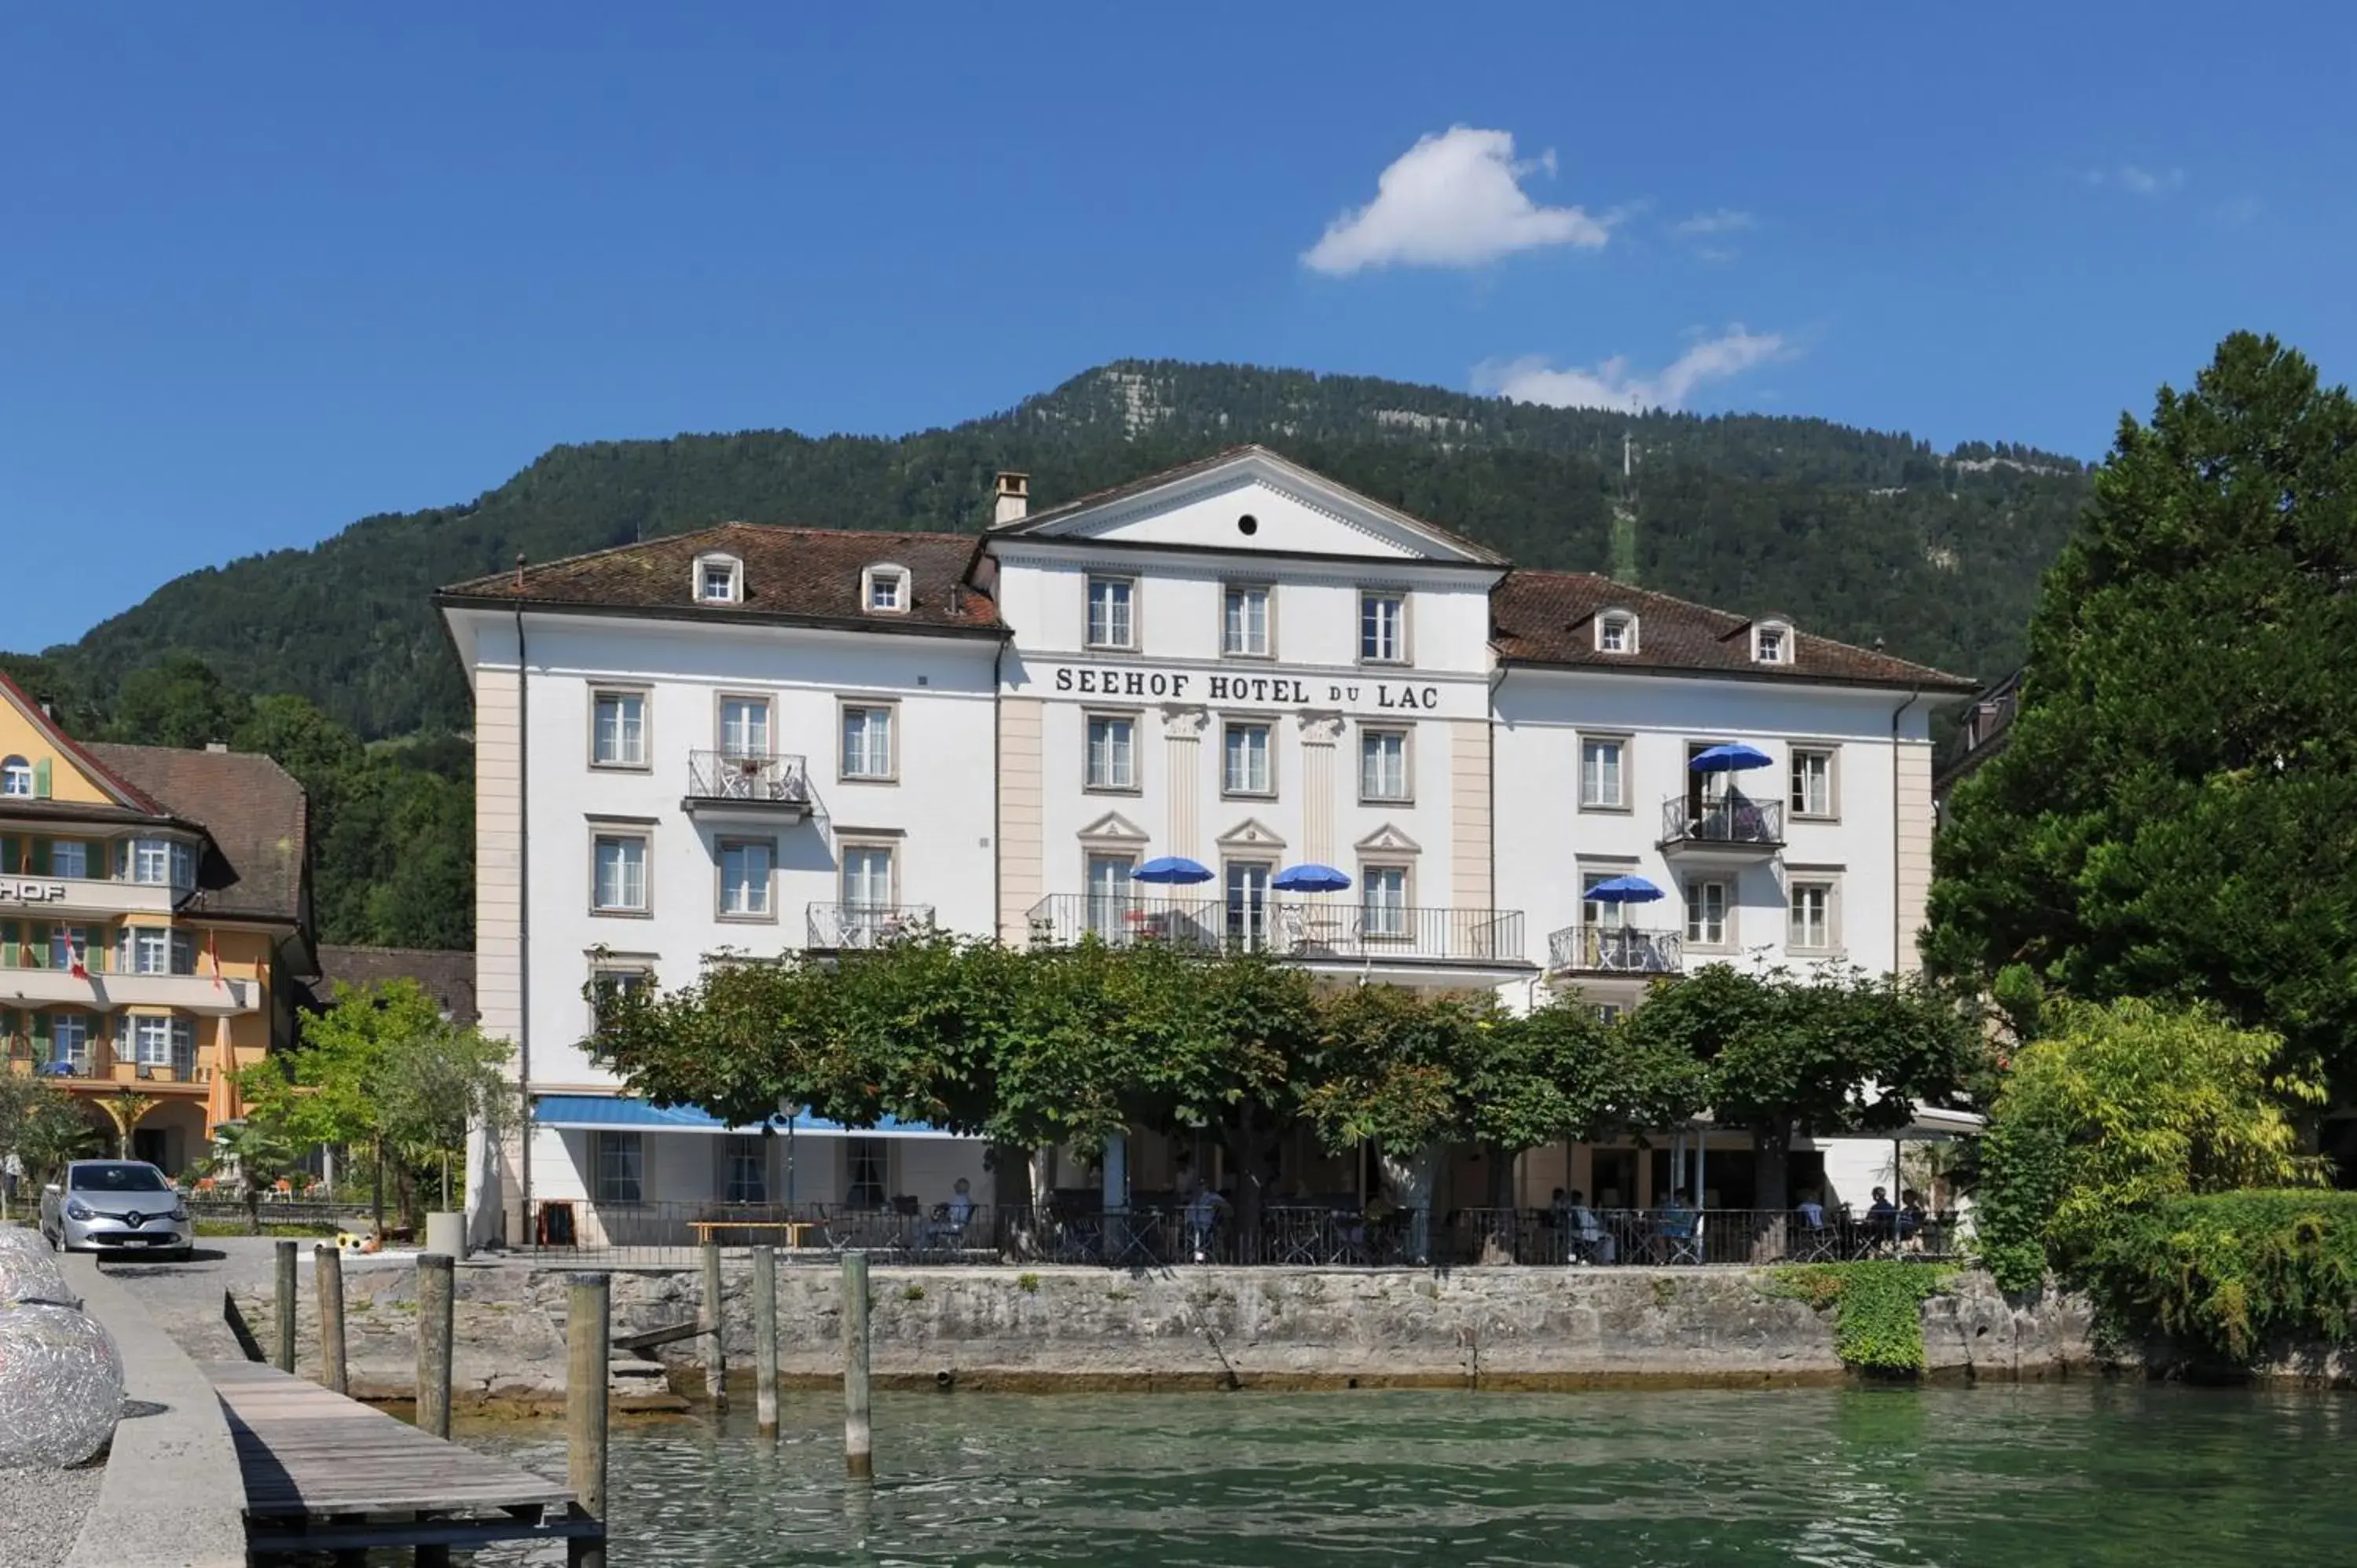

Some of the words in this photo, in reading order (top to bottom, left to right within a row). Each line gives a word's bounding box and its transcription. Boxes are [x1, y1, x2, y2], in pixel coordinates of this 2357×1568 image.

[1056, 668, 1189, 698] SEEHOF
[1209, 676, 1310, 703] HOTEL
[1329, 686, 1360, 702] DU
[1377, 684, 1439, 709] LAC
